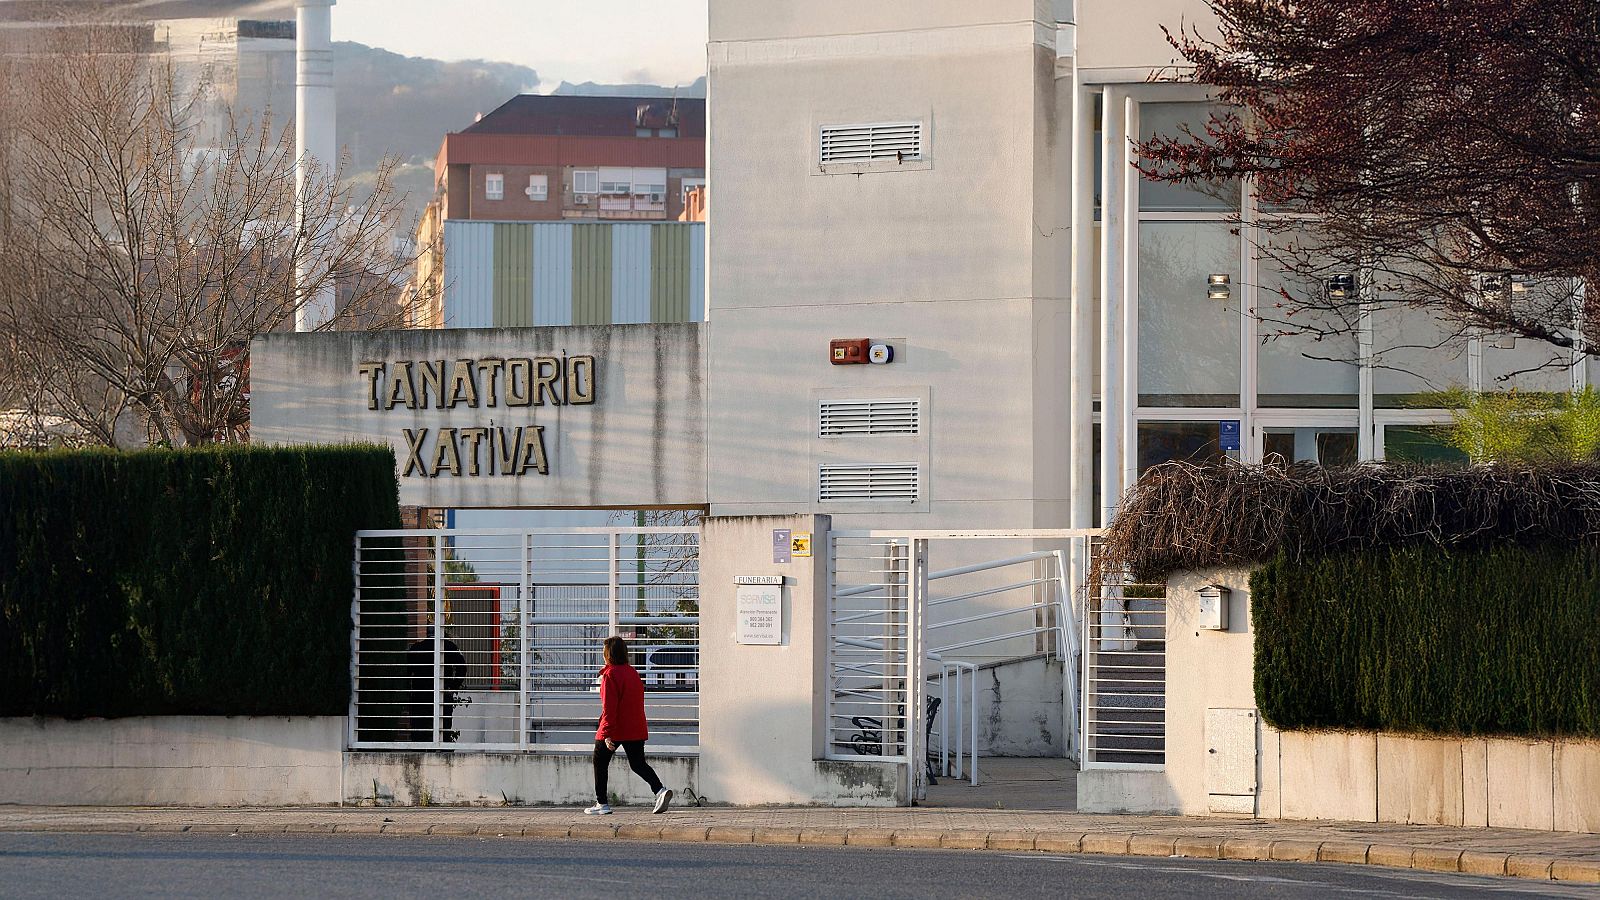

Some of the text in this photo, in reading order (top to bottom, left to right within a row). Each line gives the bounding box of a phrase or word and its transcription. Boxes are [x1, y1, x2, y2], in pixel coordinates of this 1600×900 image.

[359, 355, 596, 410] TANATORIO
[402, 425, 548, 478] XATIVA
[738, 576, 778, 584] FUNERARIA
